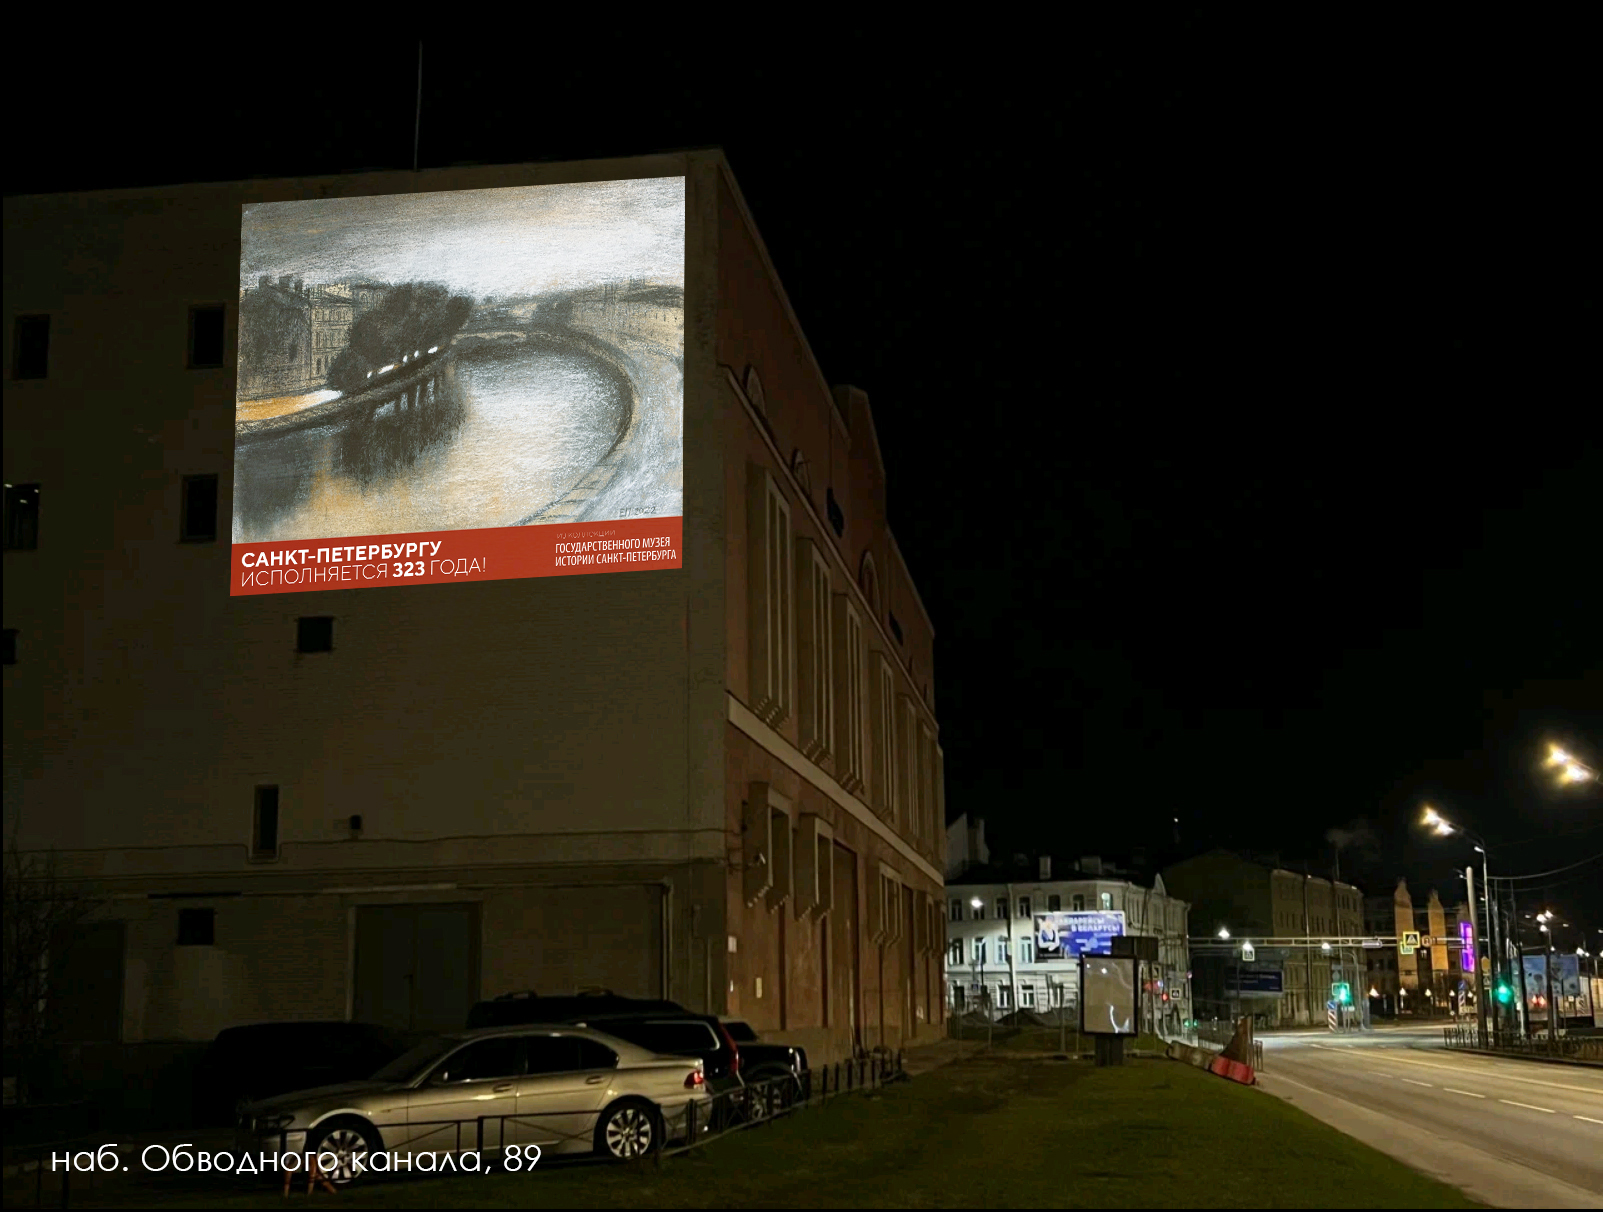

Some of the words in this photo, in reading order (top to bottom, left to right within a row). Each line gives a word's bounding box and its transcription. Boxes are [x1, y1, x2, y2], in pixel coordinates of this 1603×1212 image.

[241, 540, 442, 568] САНКТ-ПЕТЕРБУРГУ
[555, 537, 641, 555] ГОСУДАРСТВЕННОГО
[642, 536, 671, 549] МУЗЕЯ
[555, 554, 595, 567] ИСТОРИИ
[596, 549, 677, 564] САНКТ-ПЕТЕРБУРГА
[241, 562, 388, 588] ИСПОЛНЯЕТСЯ
[392, 561, 426, 578] 323
[430, 556, 487, 577] ГОДА!
